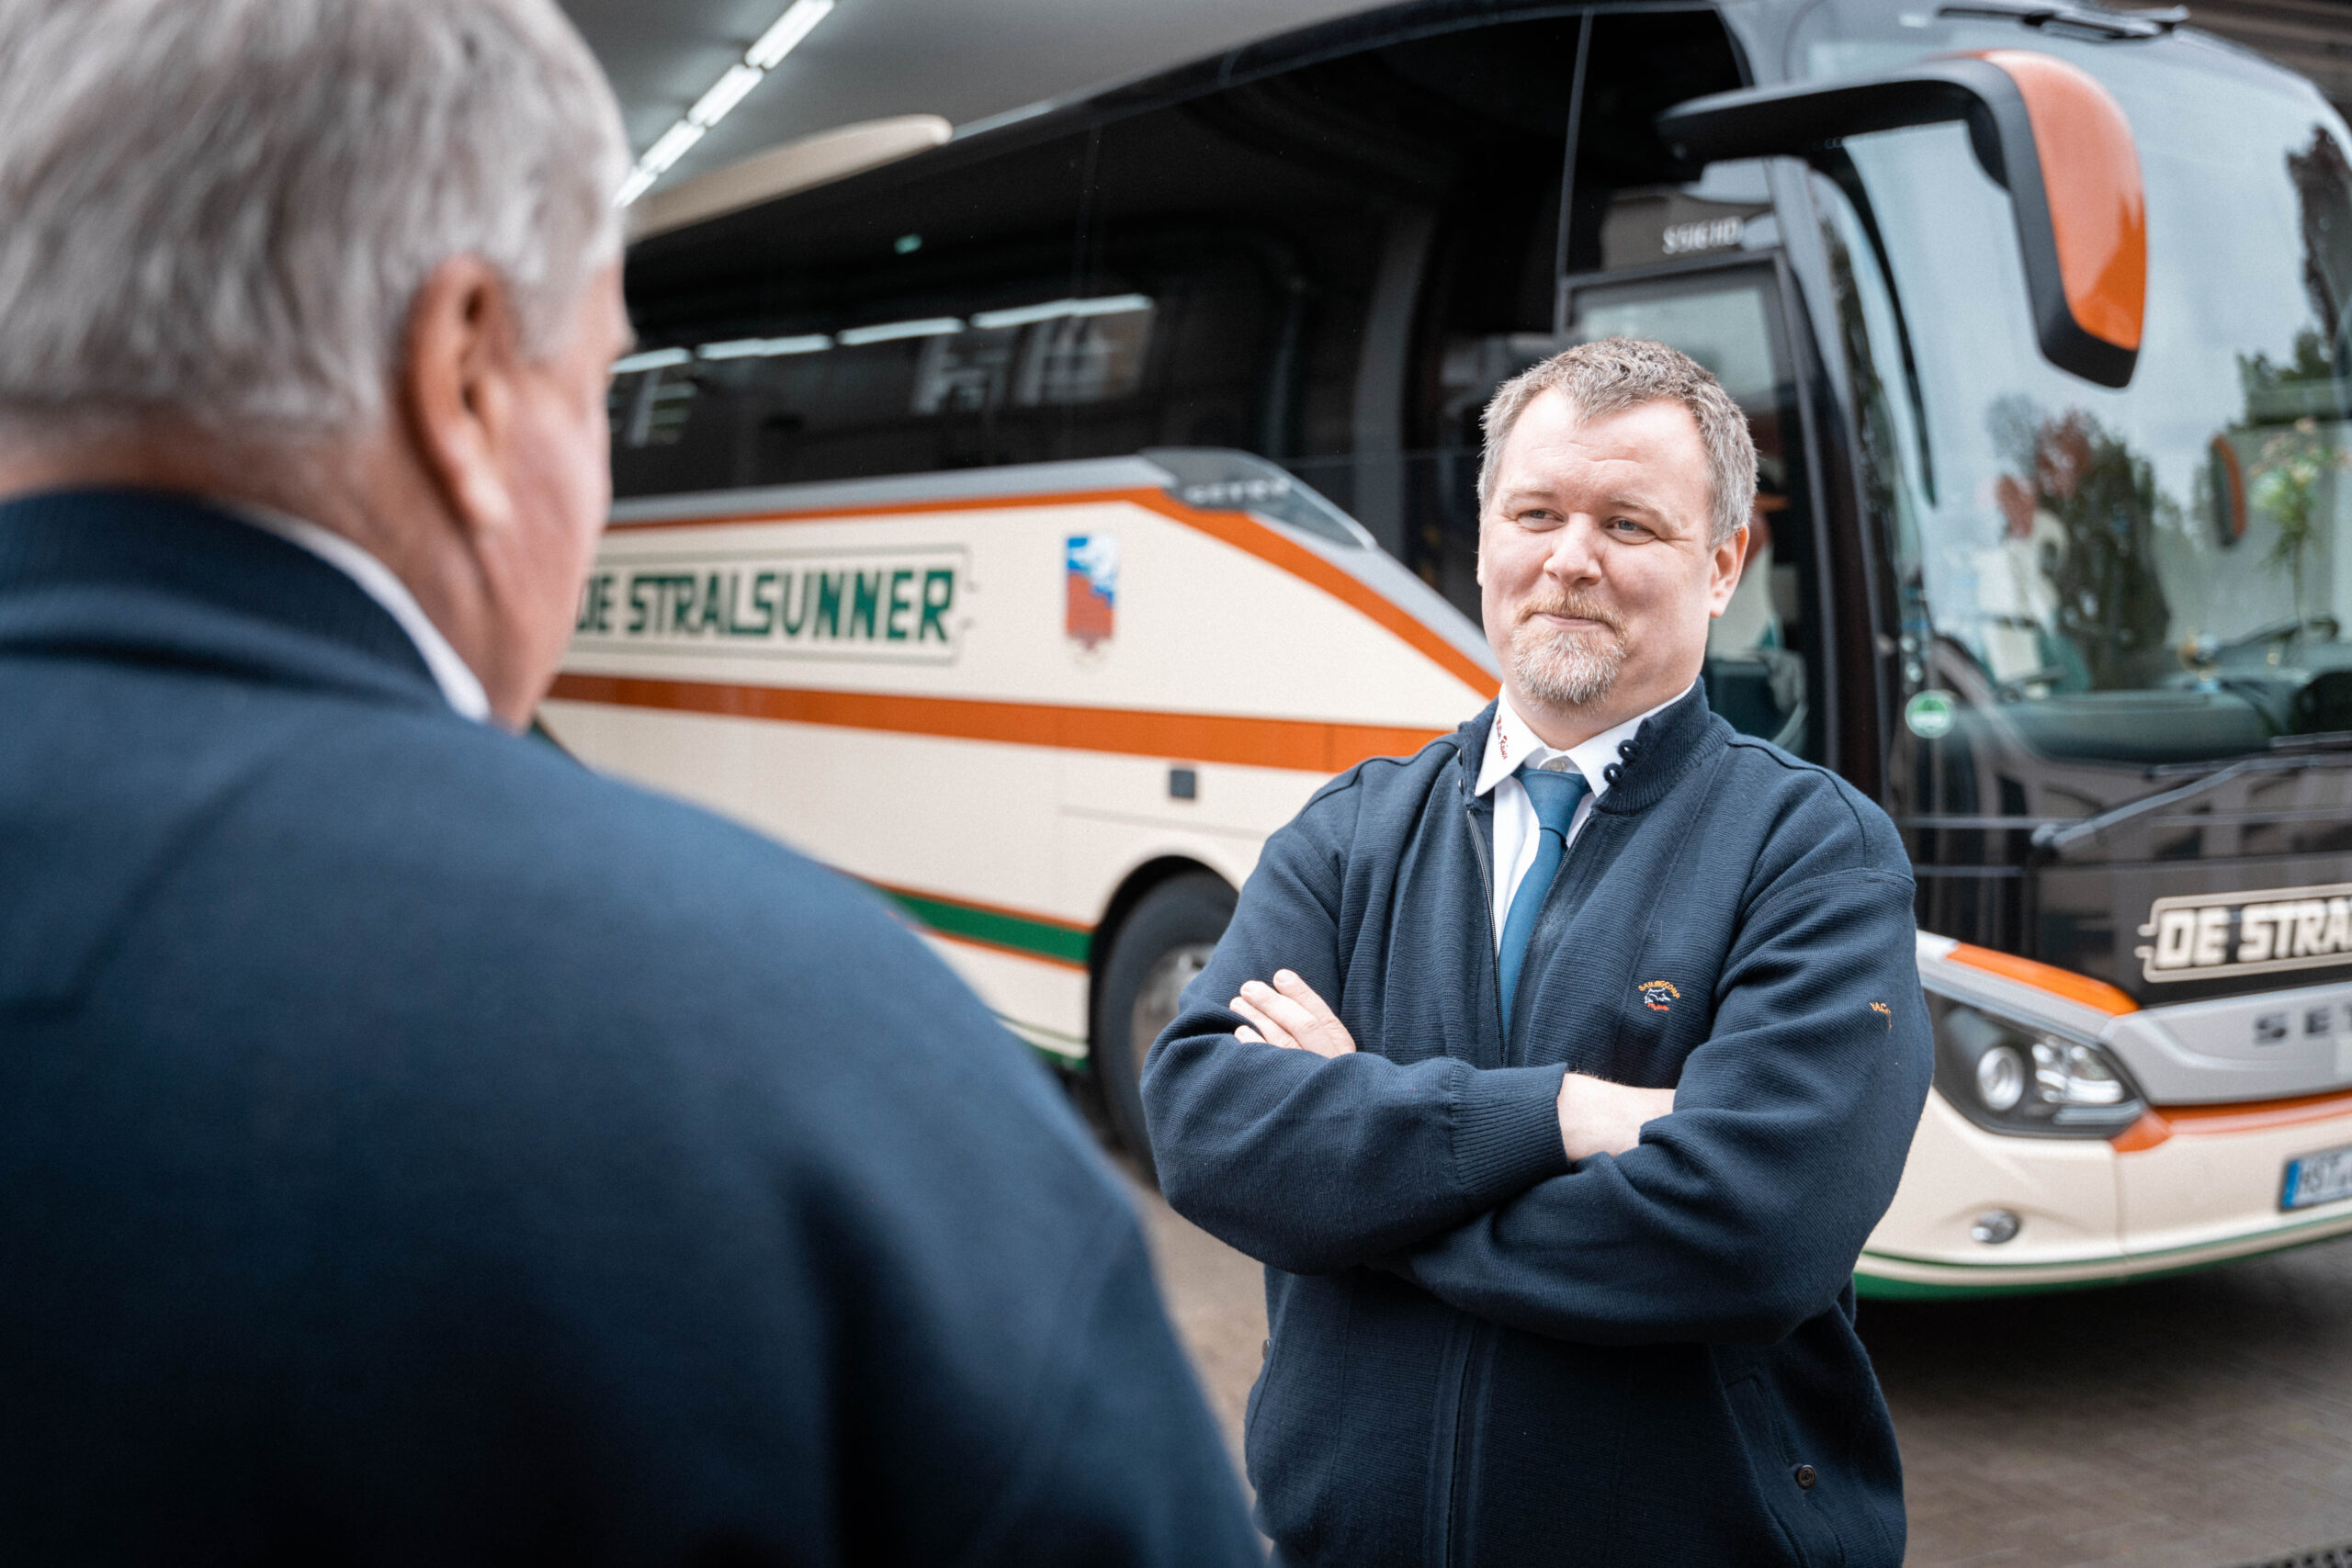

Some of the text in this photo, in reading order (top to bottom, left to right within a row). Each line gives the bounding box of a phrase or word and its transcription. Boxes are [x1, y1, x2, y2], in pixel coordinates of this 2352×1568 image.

[627, 568, 956, 642] STRALSUNNER
[2156, 897, 2352, 967] DE STRA
[2256, 1005, 2352, 1043] SE
